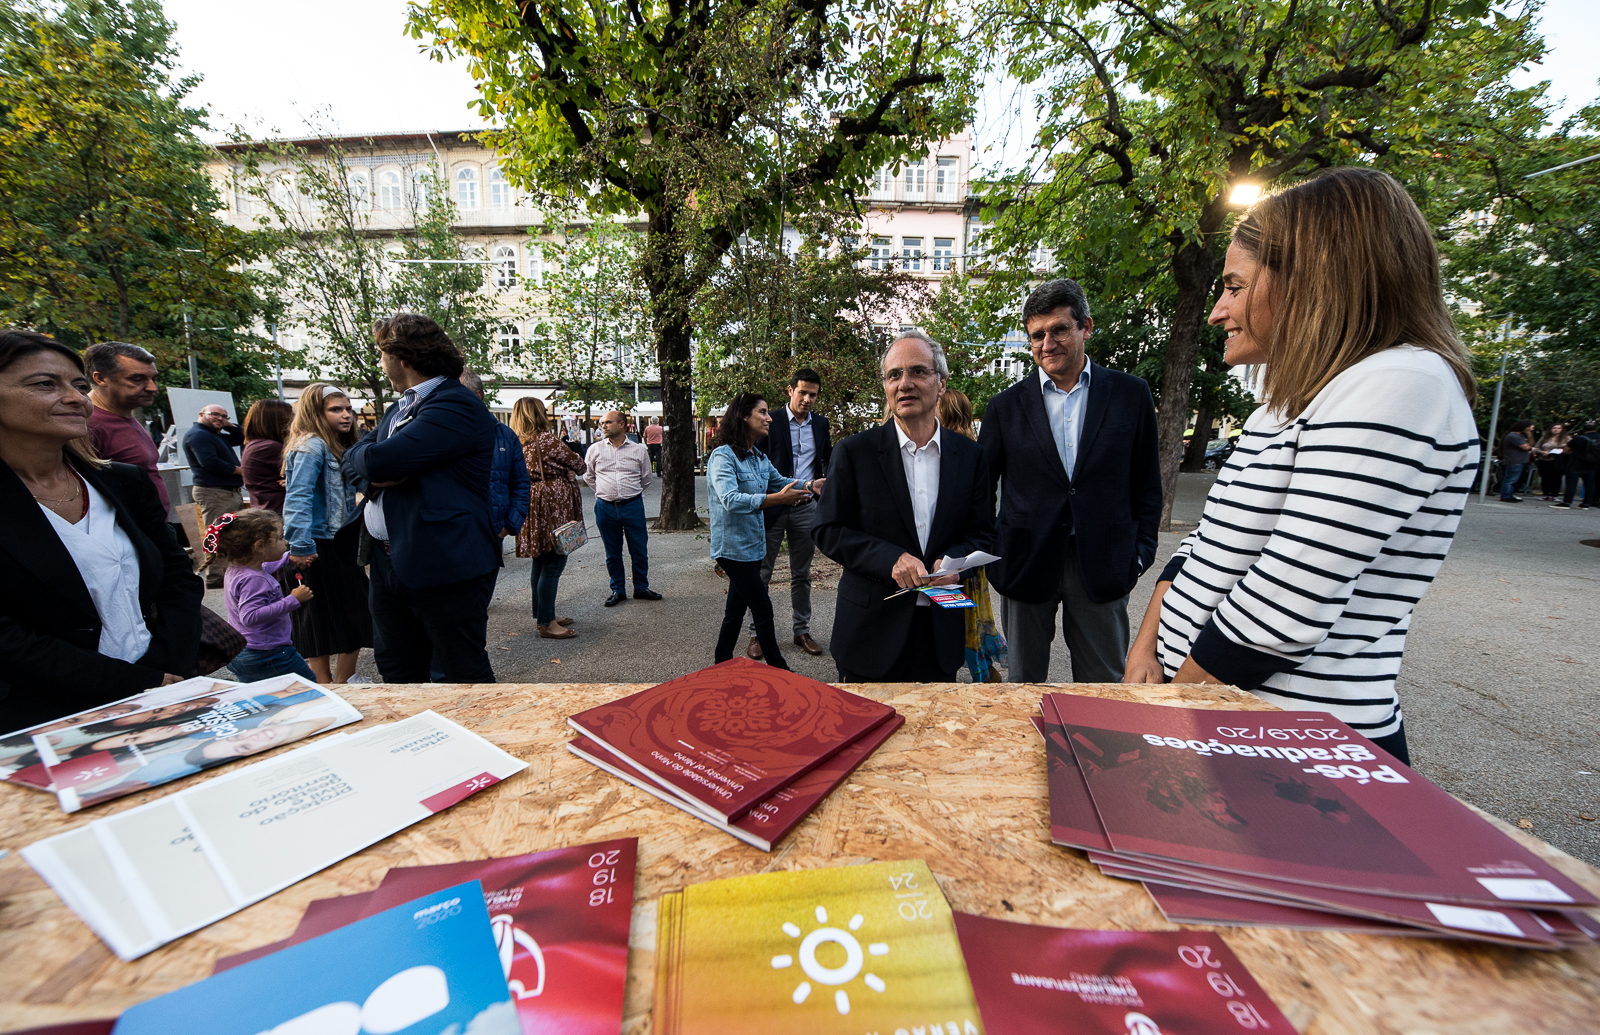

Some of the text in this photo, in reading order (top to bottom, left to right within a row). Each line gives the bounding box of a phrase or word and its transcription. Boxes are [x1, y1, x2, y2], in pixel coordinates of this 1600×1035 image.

[390, 731, 444, 754] visuais
[410, 734, 450, 752] artes
[1216, 726, 1349, 741] 2019/20
[650, 750, 673, 766] Minho
[673, 751, 697, 767] Minho
[1142, 733, 1377, 764] graduações
[671, 762, 684, 772] do
[693, 764, 706, 772] of
[1302, 763, 1410, 784] Pós-
[249, 773, 338, 807] território
[274, 777, 342, 805] gestão
[310, 782, 347, 800] civil
[682, 769, 733, 800] Universidade
[704, 768, 744, 793] University
[239, 805, 268, 818] do
[259, 785, 353, 826] proteção
[292, 798, 304, 806] e
[588, 849, 621, 868] 20
[592, 867, 617, 886] 19
[888, 871, 919, 891] 24
[589, 886, 615, 907] 18
[898, 899, 933, 922] 20
[1177, 945, 1222, 969] 20
[1206, 971, 1246, 998] 19
[1226, 1000, 1270, 1030] 18
